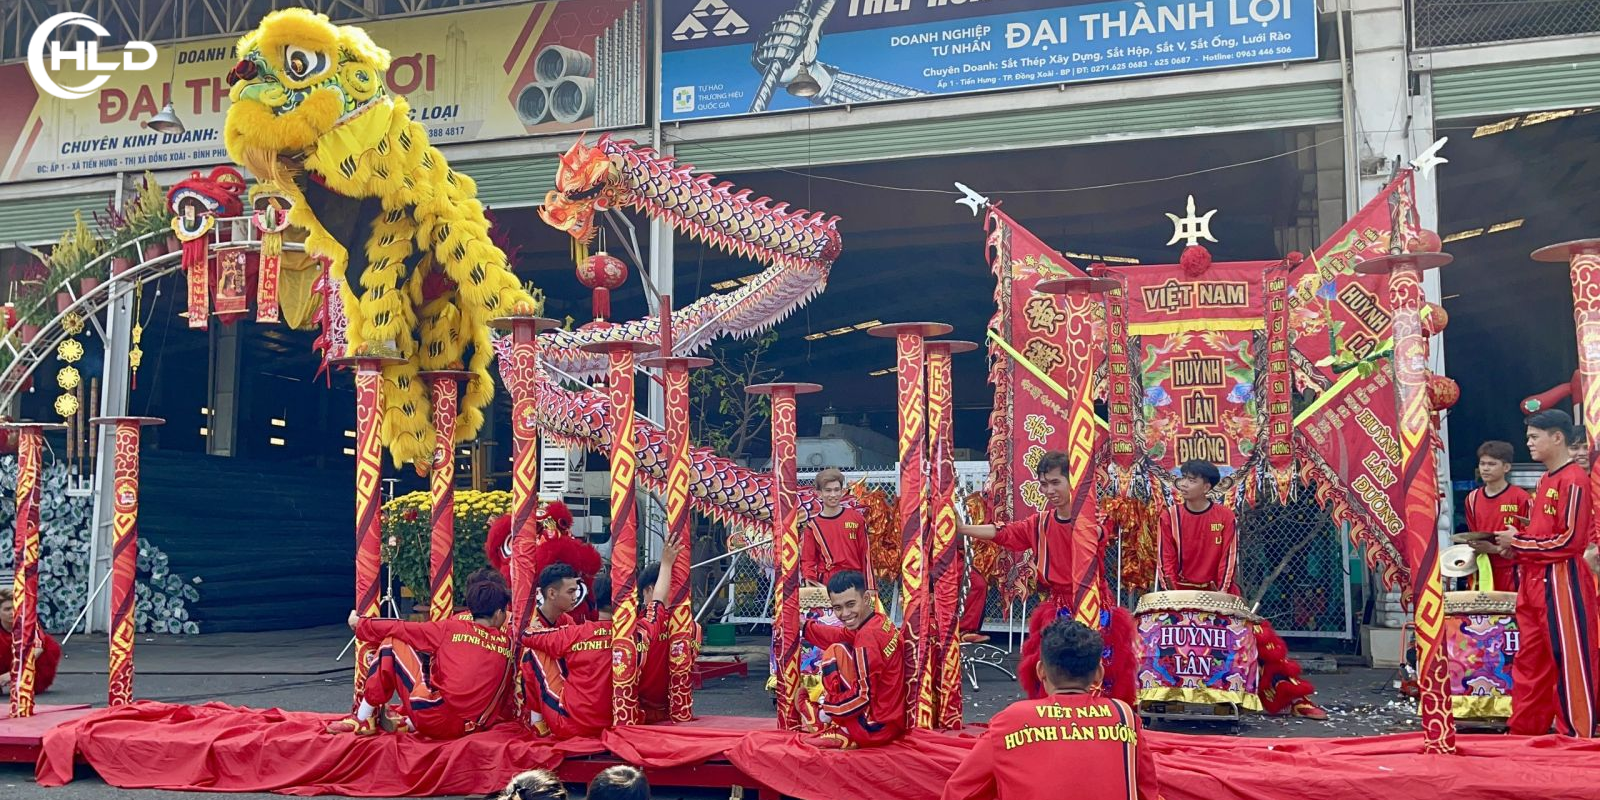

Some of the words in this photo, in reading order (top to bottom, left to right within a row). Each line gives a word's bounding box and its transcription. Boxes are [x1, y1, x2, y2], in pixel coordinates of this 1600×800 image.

[891, 31, 939, 47] DOANH
[942, 24, 991, 42] NGHIỆP
[1005, 16, 1068, 51] ĐẠI
[1079, 1, 1215, 41] THÀNH
[177, 46, 226, 66] DOANH
[923, 65, 961, 78] Chuyên
[963, 60, 998, 74] Doanh:
[1001, 56, 1018, 70] Sắt
[1021, 55, 1046, 69] Thép
[1049, 53, 1069, 66] Xây
[1072, 50, 1104, 64] Dựng,
[1106, 45, 1125, 59] Sắt
[1127, 44, 1153, 57] Hộp,
[1156, 40, 1174, 53] Sắt
[1190, 36, 1209, 50] Sắt
[1242, 31, 1267, 45] Lưới
[1269, 30, 1292, 42] Rào
[931, 44, 949, 57] TƯ
[951, 40, 991, 55] NHÂN
[98, 81, 171, 129] ĐẠI
[421, 104, 460, 122] LOẠI
[61, 135, 119, 155] CHUYÊN
[122, 133, 158, 149] KINH
[162, 128, 219, 145] DOANH:
[1144, 282, 1193, 311] VIỆT
[1199, 284, 1245, 306] NAM
[1341, 286, 1391, 333] HUỲNH
[1175, 353, 1221, 386] HUỲNH
[1186, 393, 1214, 424] LÂN
[1179, 431, 1225, 462] ĐƯỜNG
[1358, 409, 1402, 465] HUỲNH
[1363, 453, 1397, 487] LÂN
[1354, 477, 1403, 533] ĐƯỜNG
[1160, 622, 1228, 648] HUỲNH
[1174, 651, 1213, 676] LÂN
[1035, 703, 1073, 721] VIỆT
[1075, 704, 1113, 718] NAM
[1004, 724, 1059, 750] HUỲNH
[1061, 723, 1095, 741] LÂN
